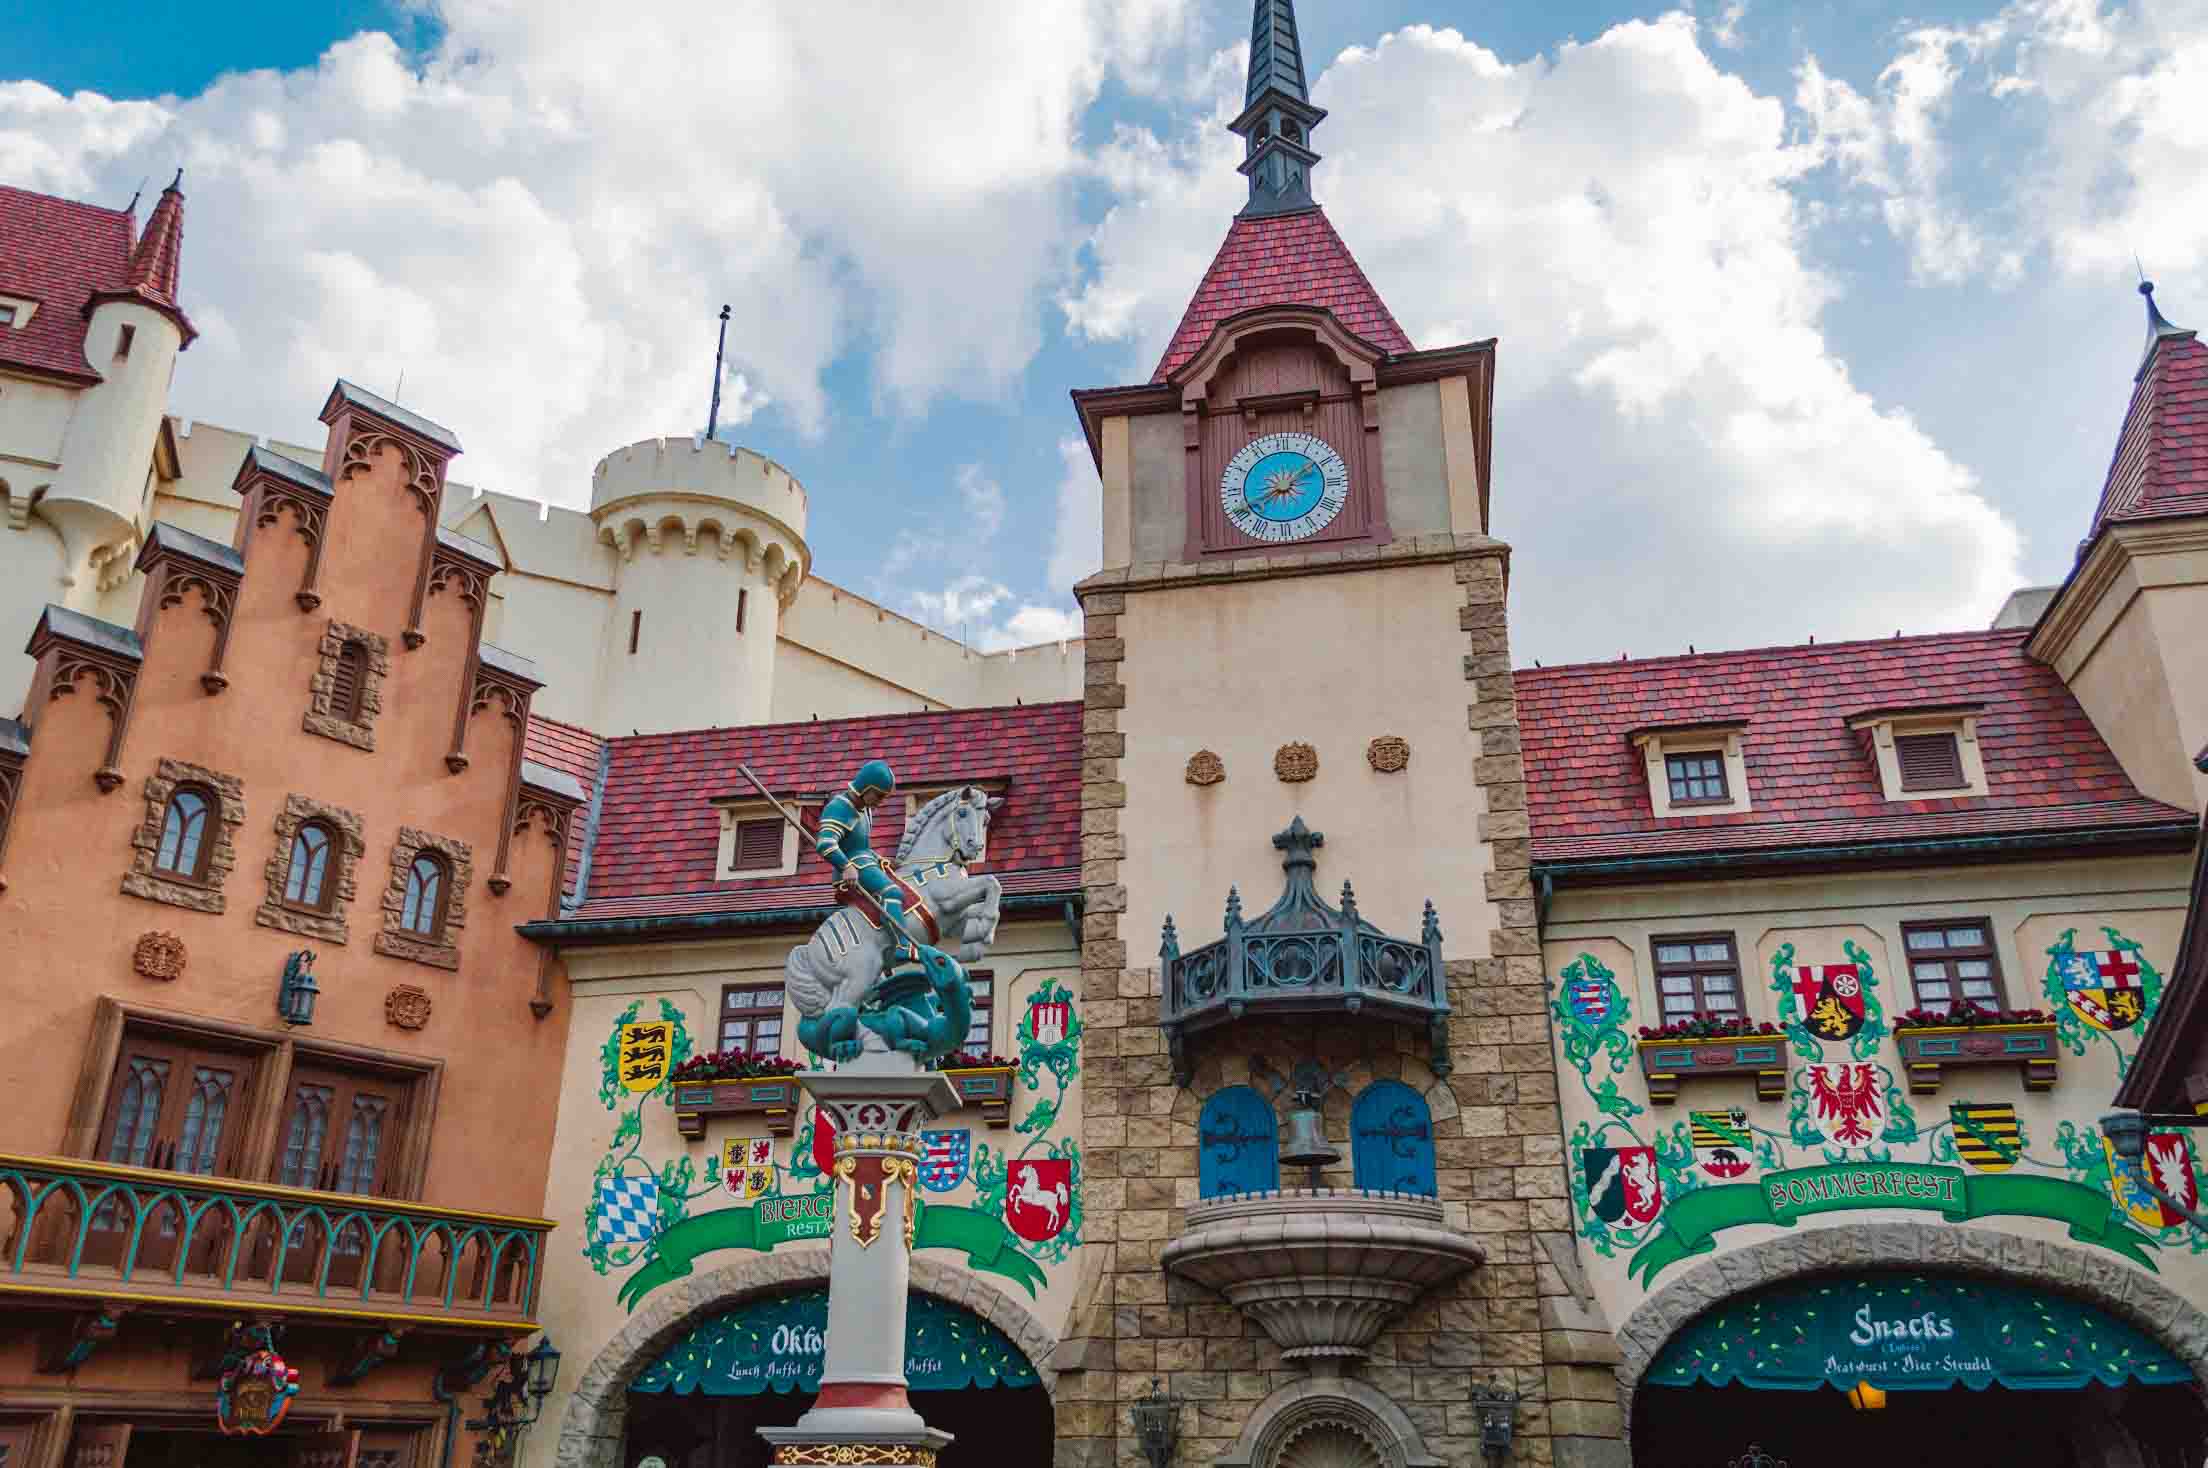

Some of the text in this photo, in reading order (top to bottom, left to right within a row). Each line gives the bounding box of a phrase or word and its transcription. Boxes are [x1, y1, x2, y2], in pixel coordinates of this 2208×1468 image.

[1770, 1171, 1959, 1208] SOMMERFEST
[761, 1194, 831, 1224] BIERG
[787, 1221, 831, 1237] RESTA
[771, 1323, 823, 1355] Okto
[1850, 1303, 1953, 1345] Snacks
[727, 1360, 760, 1380] Lunch
[807, 1363, 816, 1376] &
[1942, 1352, 1993, 1372] Strudel
